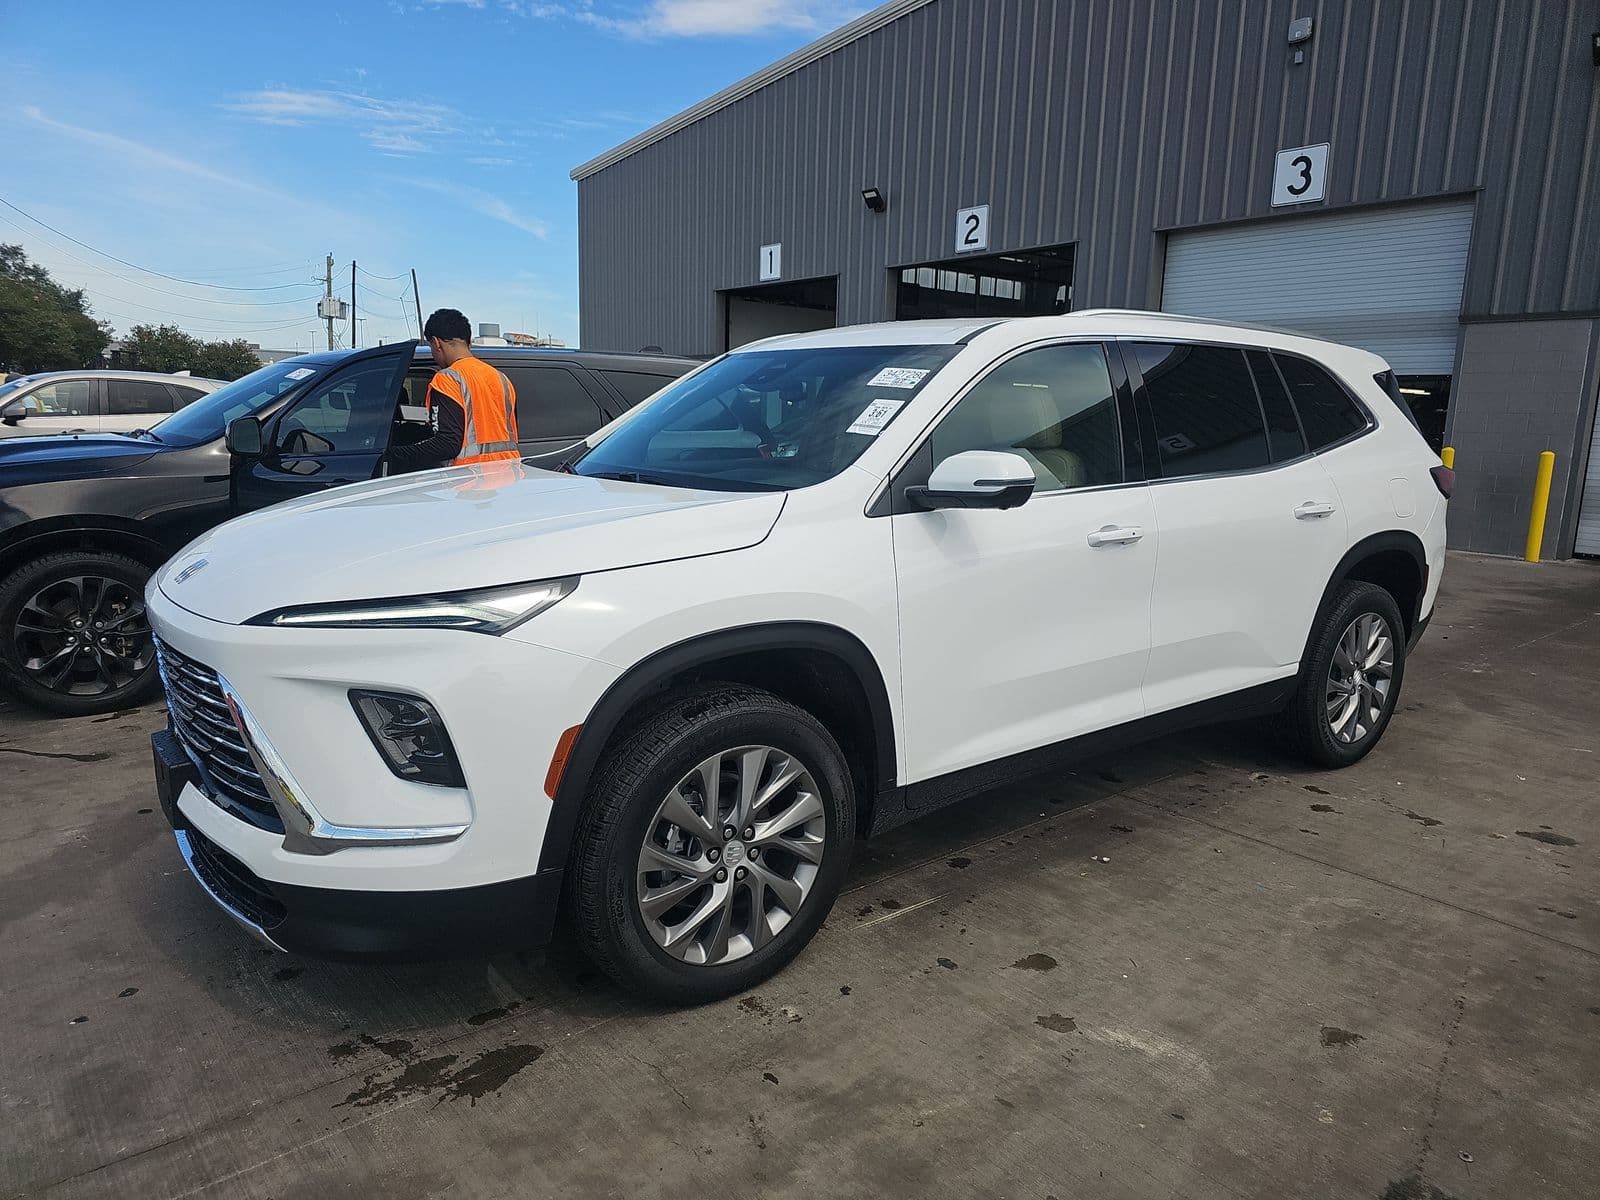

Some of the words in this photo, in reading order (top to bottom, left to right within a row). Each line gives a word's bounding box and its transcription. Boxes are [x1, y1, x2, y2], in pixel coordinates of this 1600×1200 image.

[1286, 155, 1312, 195] 3
[964, 214, 979, 244] 2
[769, 250, 773, 274] 1
